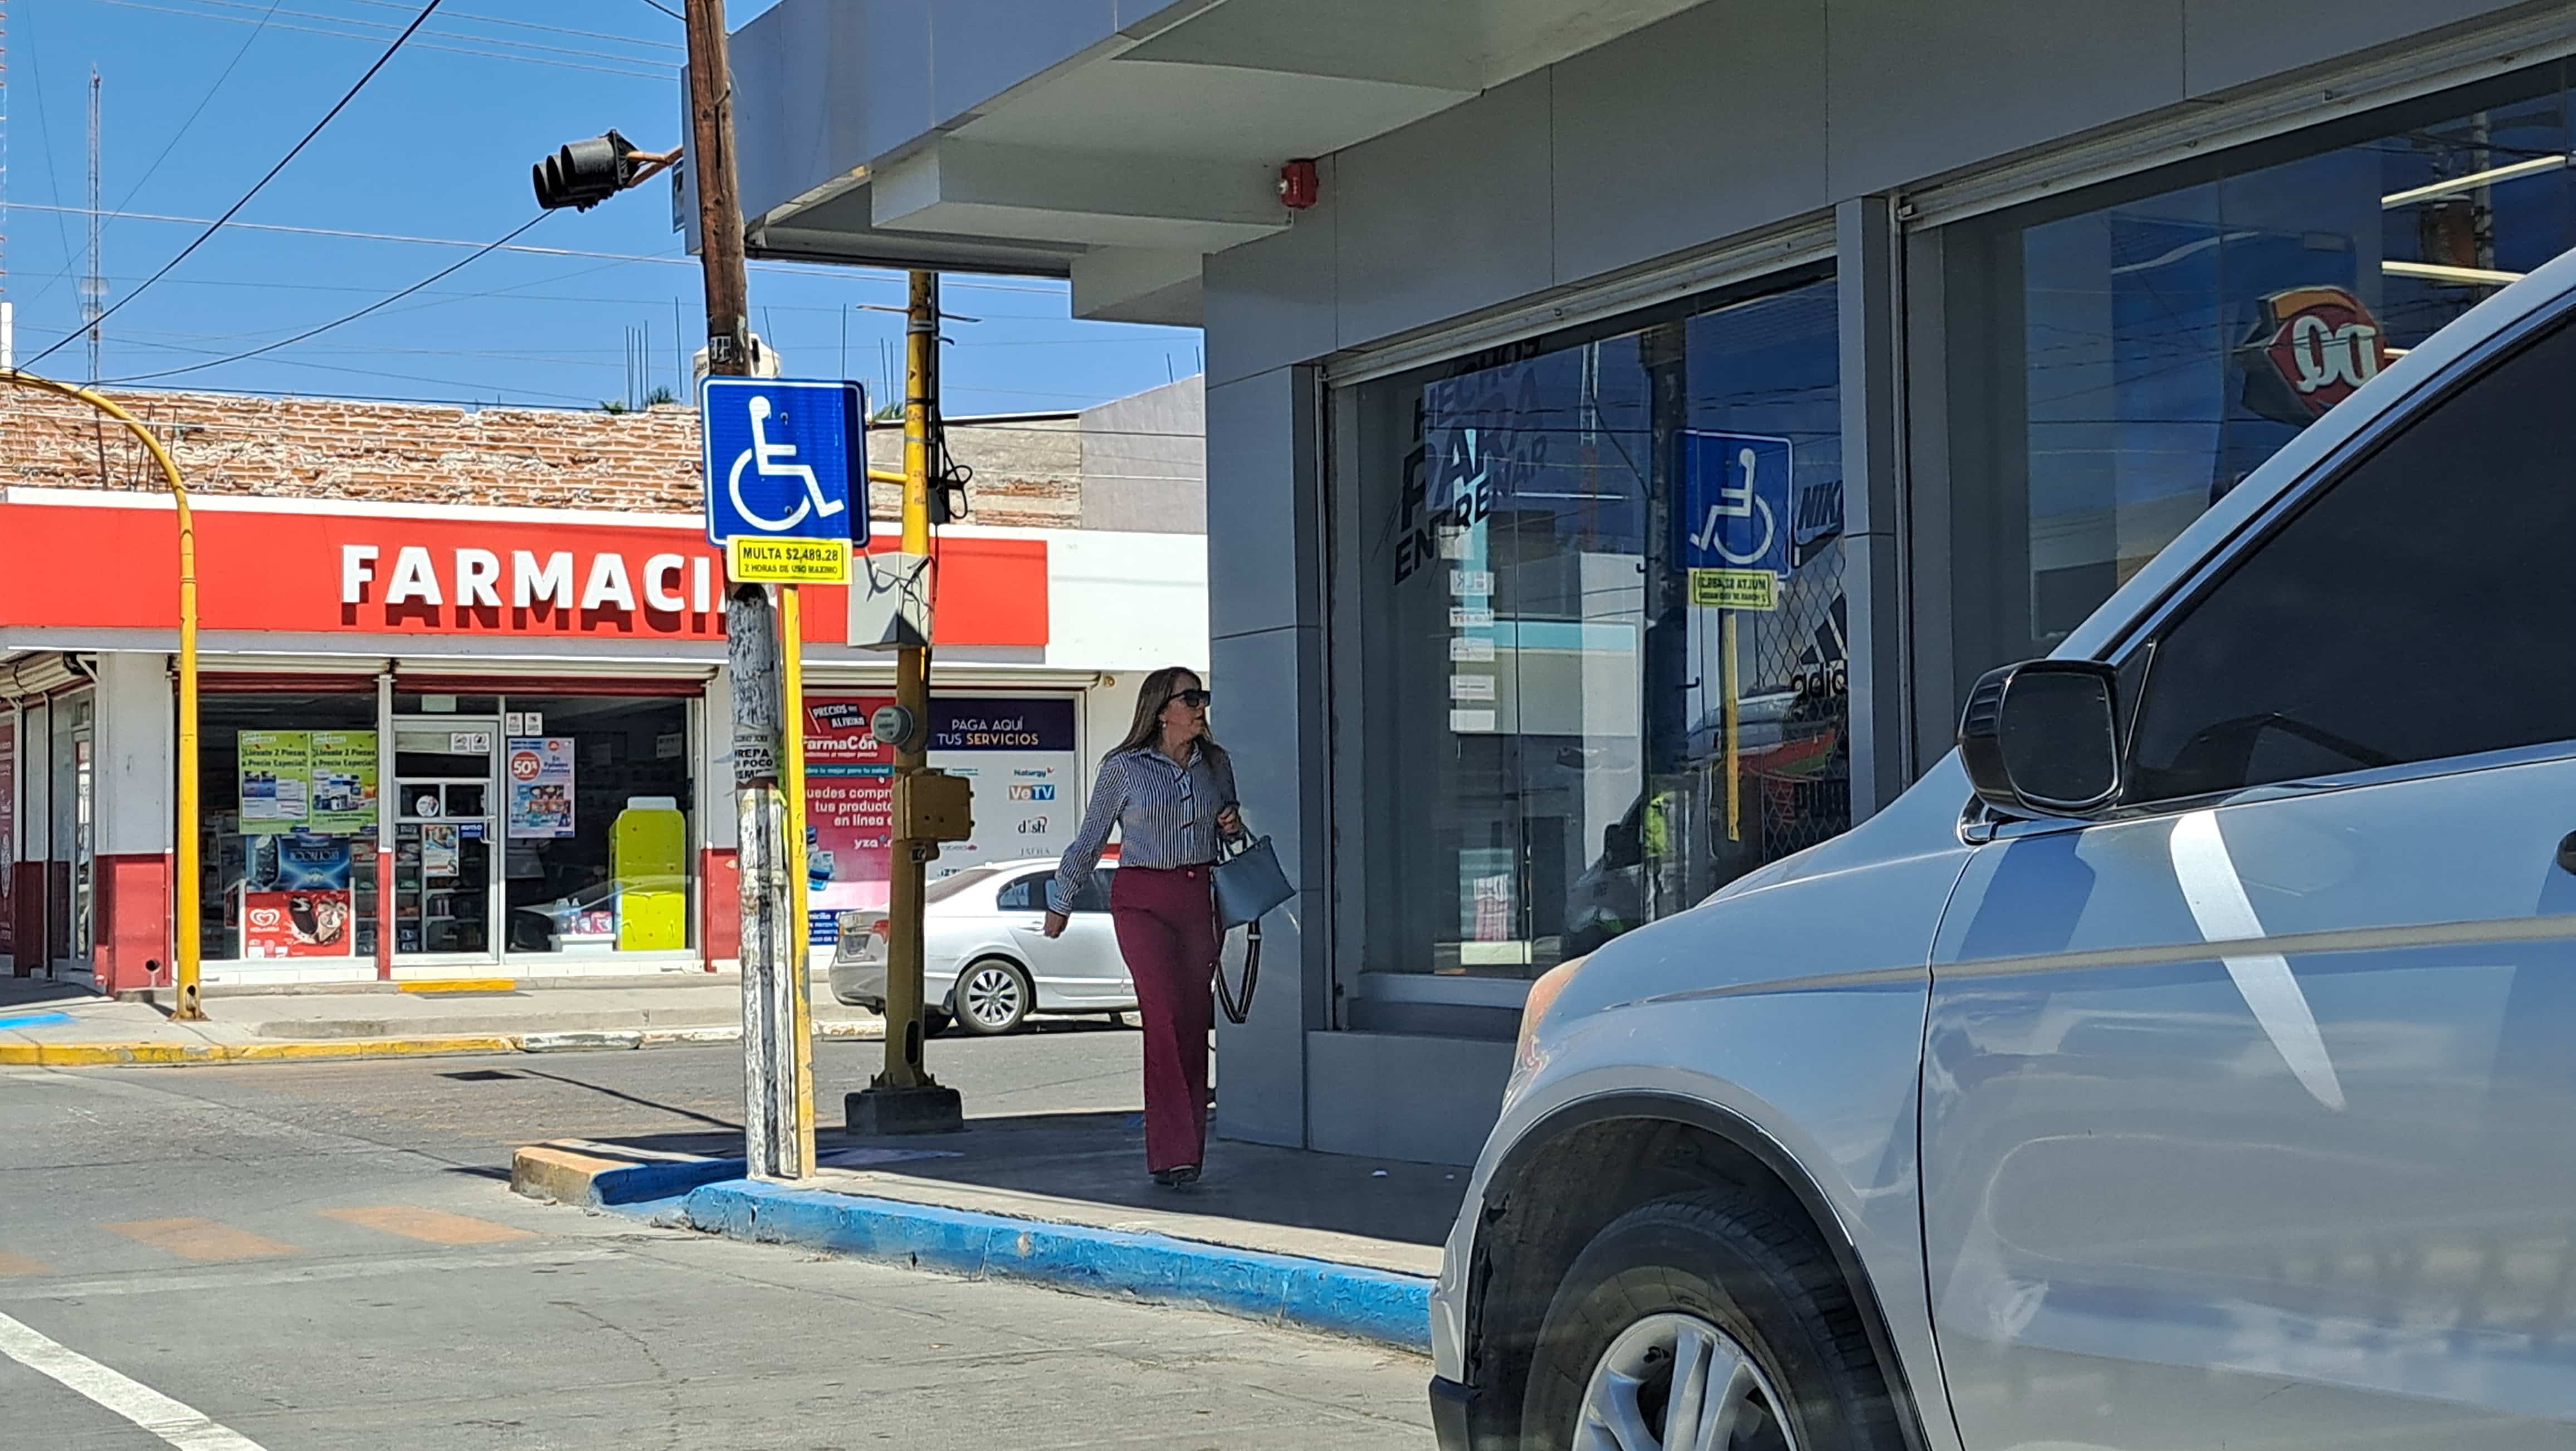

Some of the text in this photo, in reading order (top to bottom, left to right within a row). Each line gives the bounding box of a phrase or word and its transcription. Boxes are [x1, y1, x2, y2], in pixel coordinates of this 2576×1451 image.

[1796, 480, 1845, 531] NIK
[743, 547, 781, 559] MULTA
[744, 564, 749, 572] 2
[752, 564, 777, 573] HORAS
[341, 544, 726, 612] FARMACI
[952, 716, 1023, 731] PAGA AQUÍ
[937, 733, 1038, 745] TUS SERVICIOS
[743, 758, 773, 768] POCO
[1014, 769, 1046, 778] Naturgy
[1010, 785, 1053, 800] VeTV
[815, 800, 836, 812] tus
[834, 816, 850, 826] en
[852, 814, 884, 826] línea
[1018, 817, 1047, 834] dish
